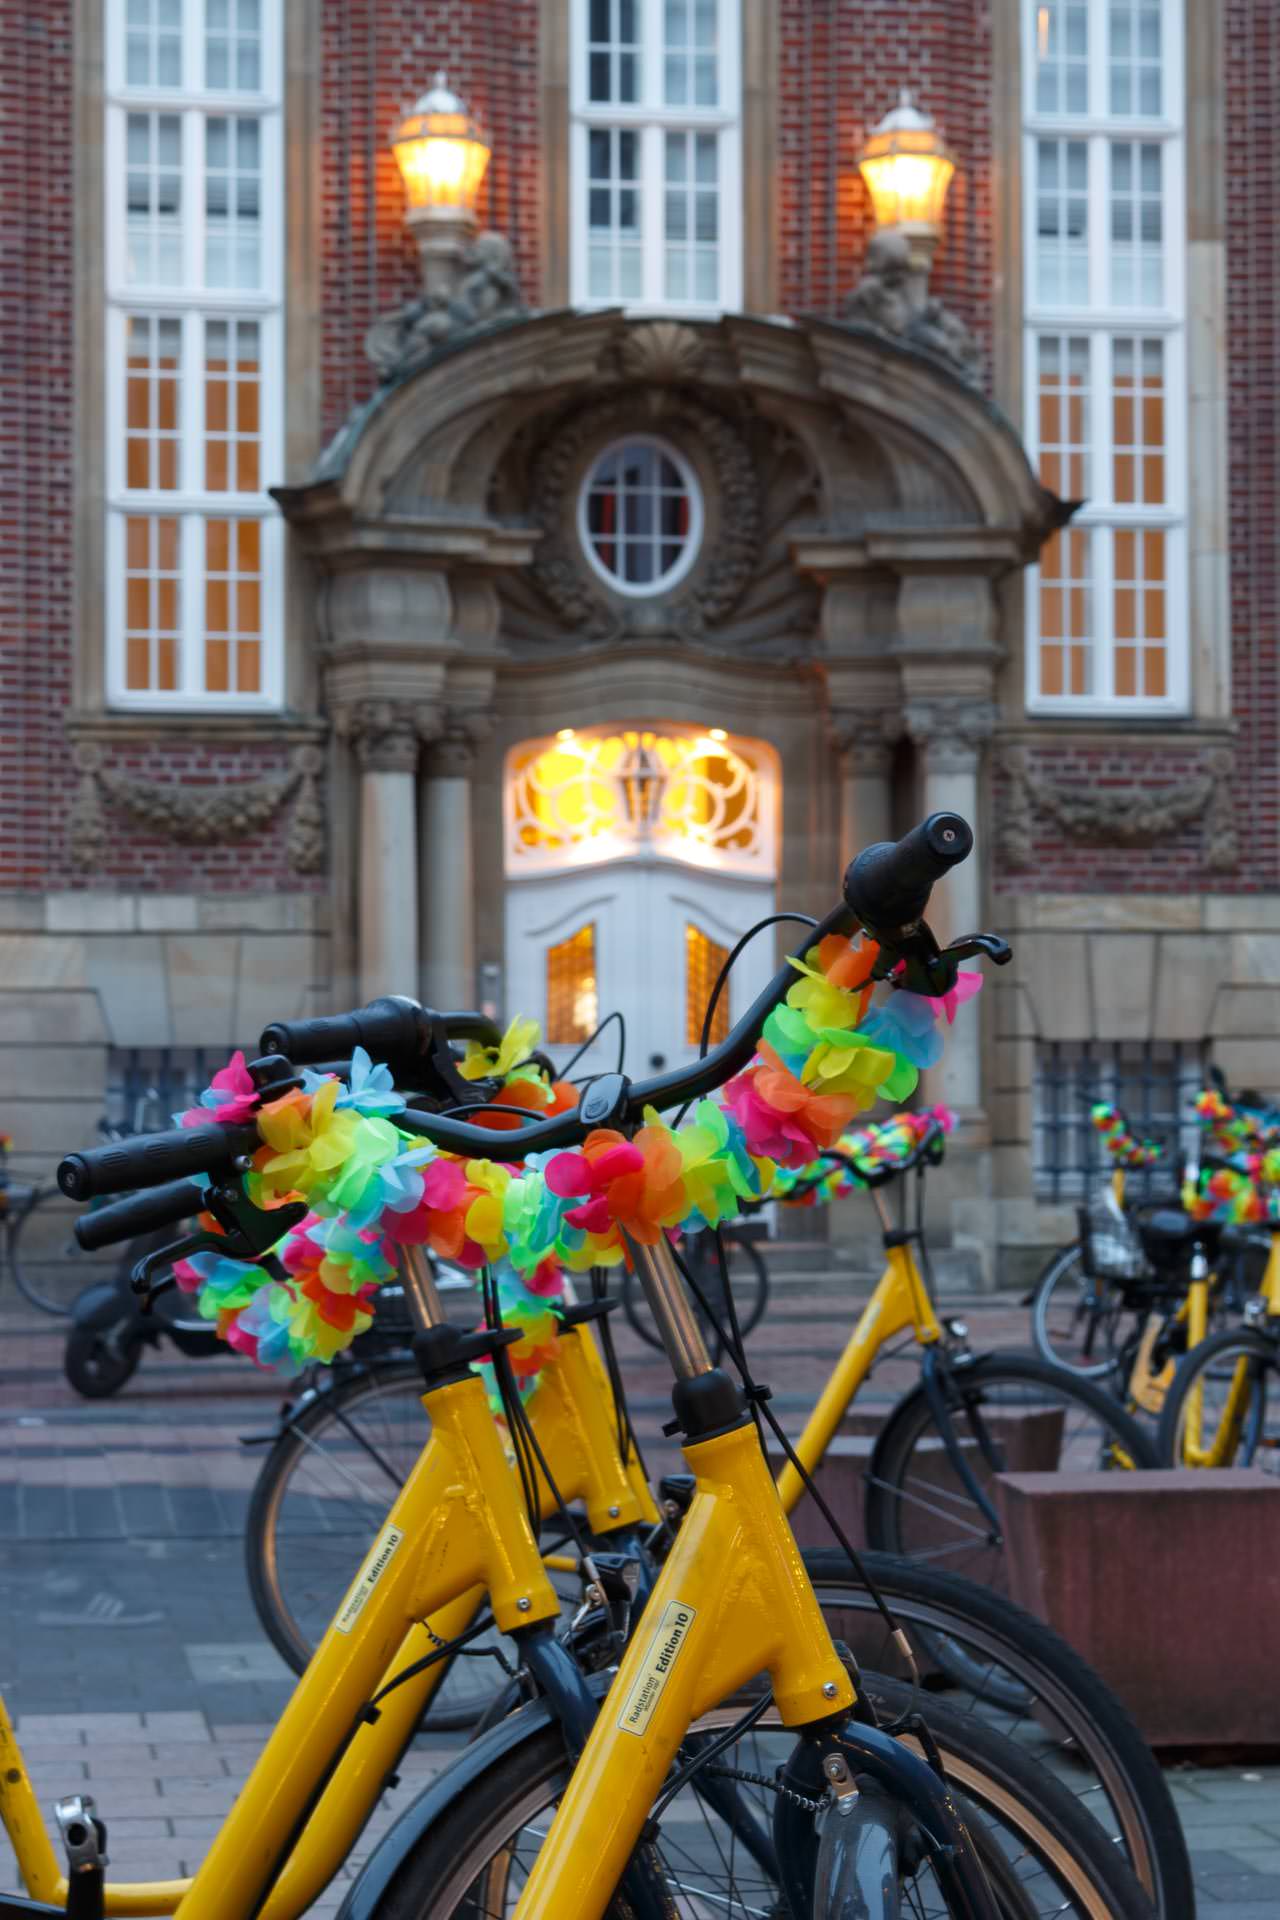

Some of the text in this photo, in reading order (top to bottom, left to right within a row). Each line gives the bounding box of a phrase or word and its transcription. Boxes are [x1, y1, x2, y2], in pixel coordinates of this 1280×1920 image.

[368, 1534, 398, 1583] Edition 10
[656, 1612, 688, 1673] Edition 10
[629, 1676, 656, 1723] Radstation
